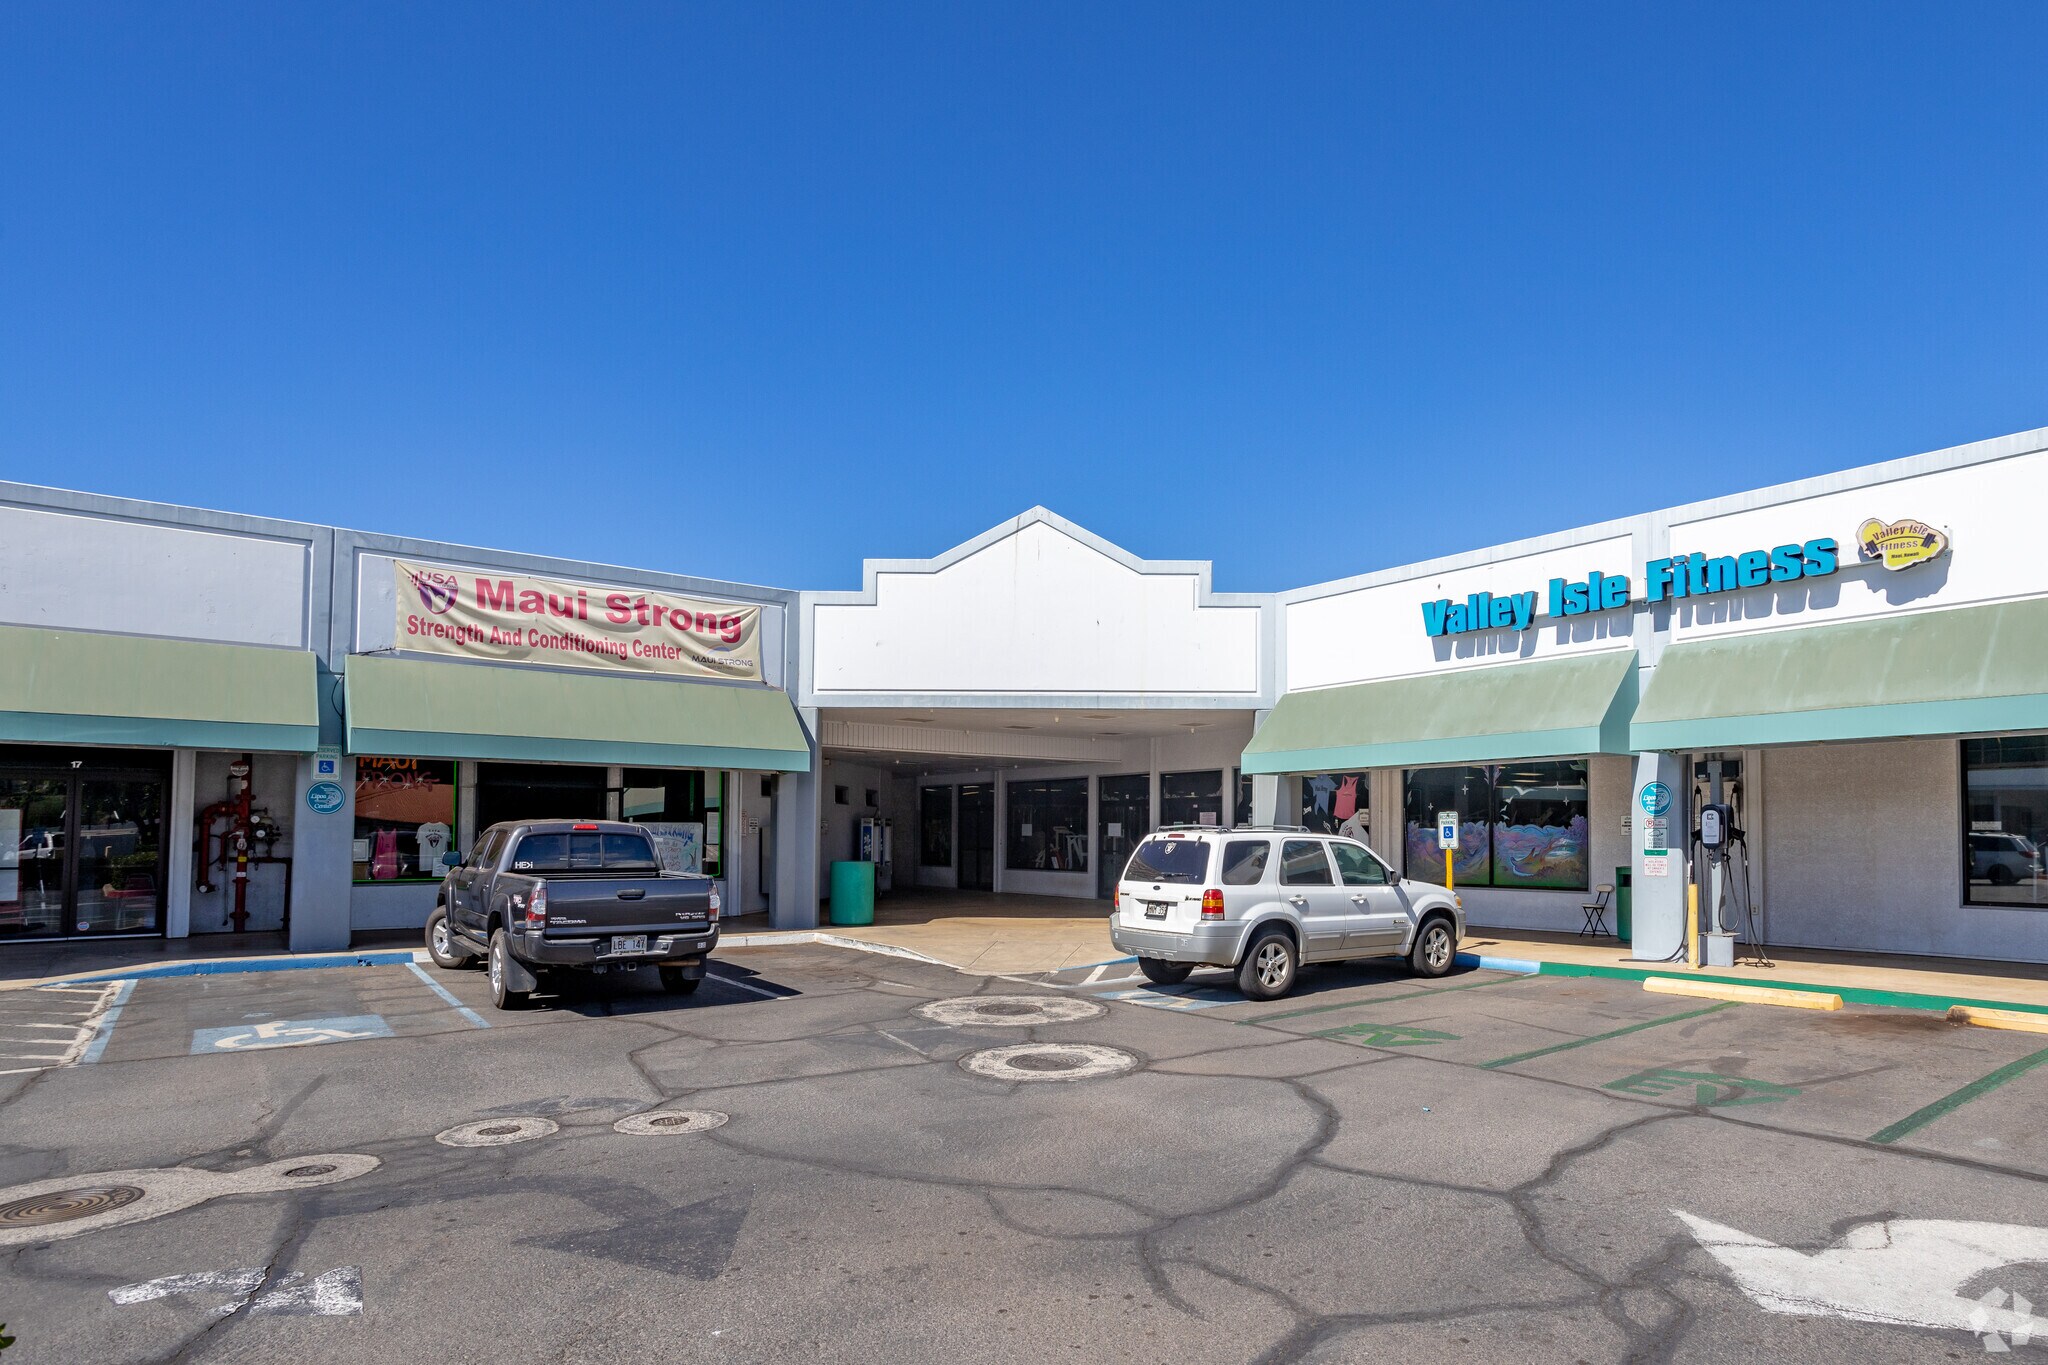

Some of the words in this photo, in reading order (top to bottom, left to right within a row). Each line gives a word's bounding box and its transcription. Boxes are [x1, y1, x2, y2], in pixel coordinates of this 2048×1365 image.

[1872, 525, 1906, 541] Valley
[1908, 524, 1929, 536] Isle
[1880, 540, 1918, 551] Fitness
[419, 570, 459, 587] USA
[1421, 590, 1538, 638] Valley
[1548, 571, 1630, 620] Isle
[1646, 537, 1840, 603] Fitness
[475, 577, 589, 621] Maui
[605, 592, 742, 644] Strong
[407, 614, 485, 646] Strength
[489, 625, 523, 648] And
[527, 627, 628, 661] Conditioning
[632, 638, 682, 661] Center
[692, 654, 716, 665] MAUI
[717, 657, 754, 667] STRONG
[70, 760, 83, 769] 17
[357, 769, 441, 793] TRONG
[613, 940, 627, 951] LBE
[632, 939, 645, 950] 147
